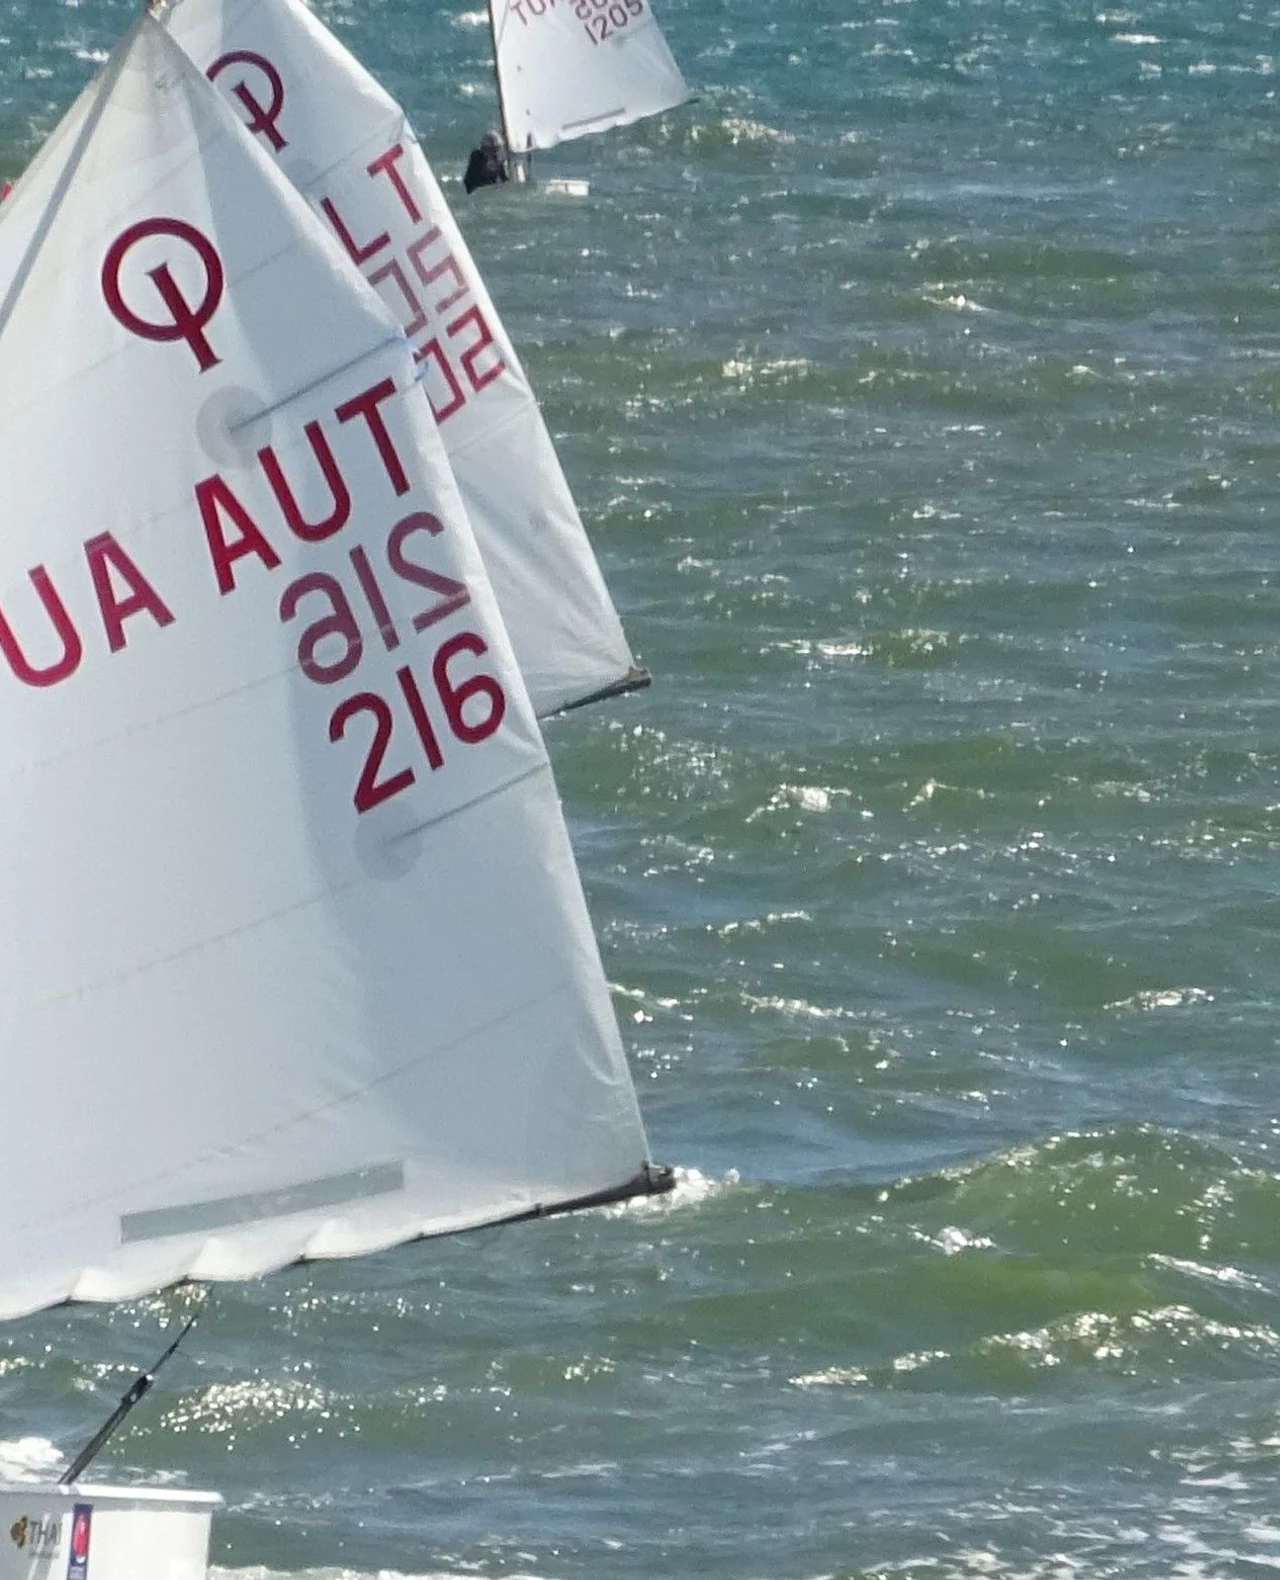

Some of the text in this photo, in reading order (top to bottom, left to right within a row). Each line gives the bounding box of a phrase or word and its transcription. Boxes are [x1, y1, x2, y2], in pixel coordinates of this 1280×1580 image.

[322, 143, 421, 264] LT
[195, 378, 411, 595] AUT
[329, 633, 506, 815] 216
